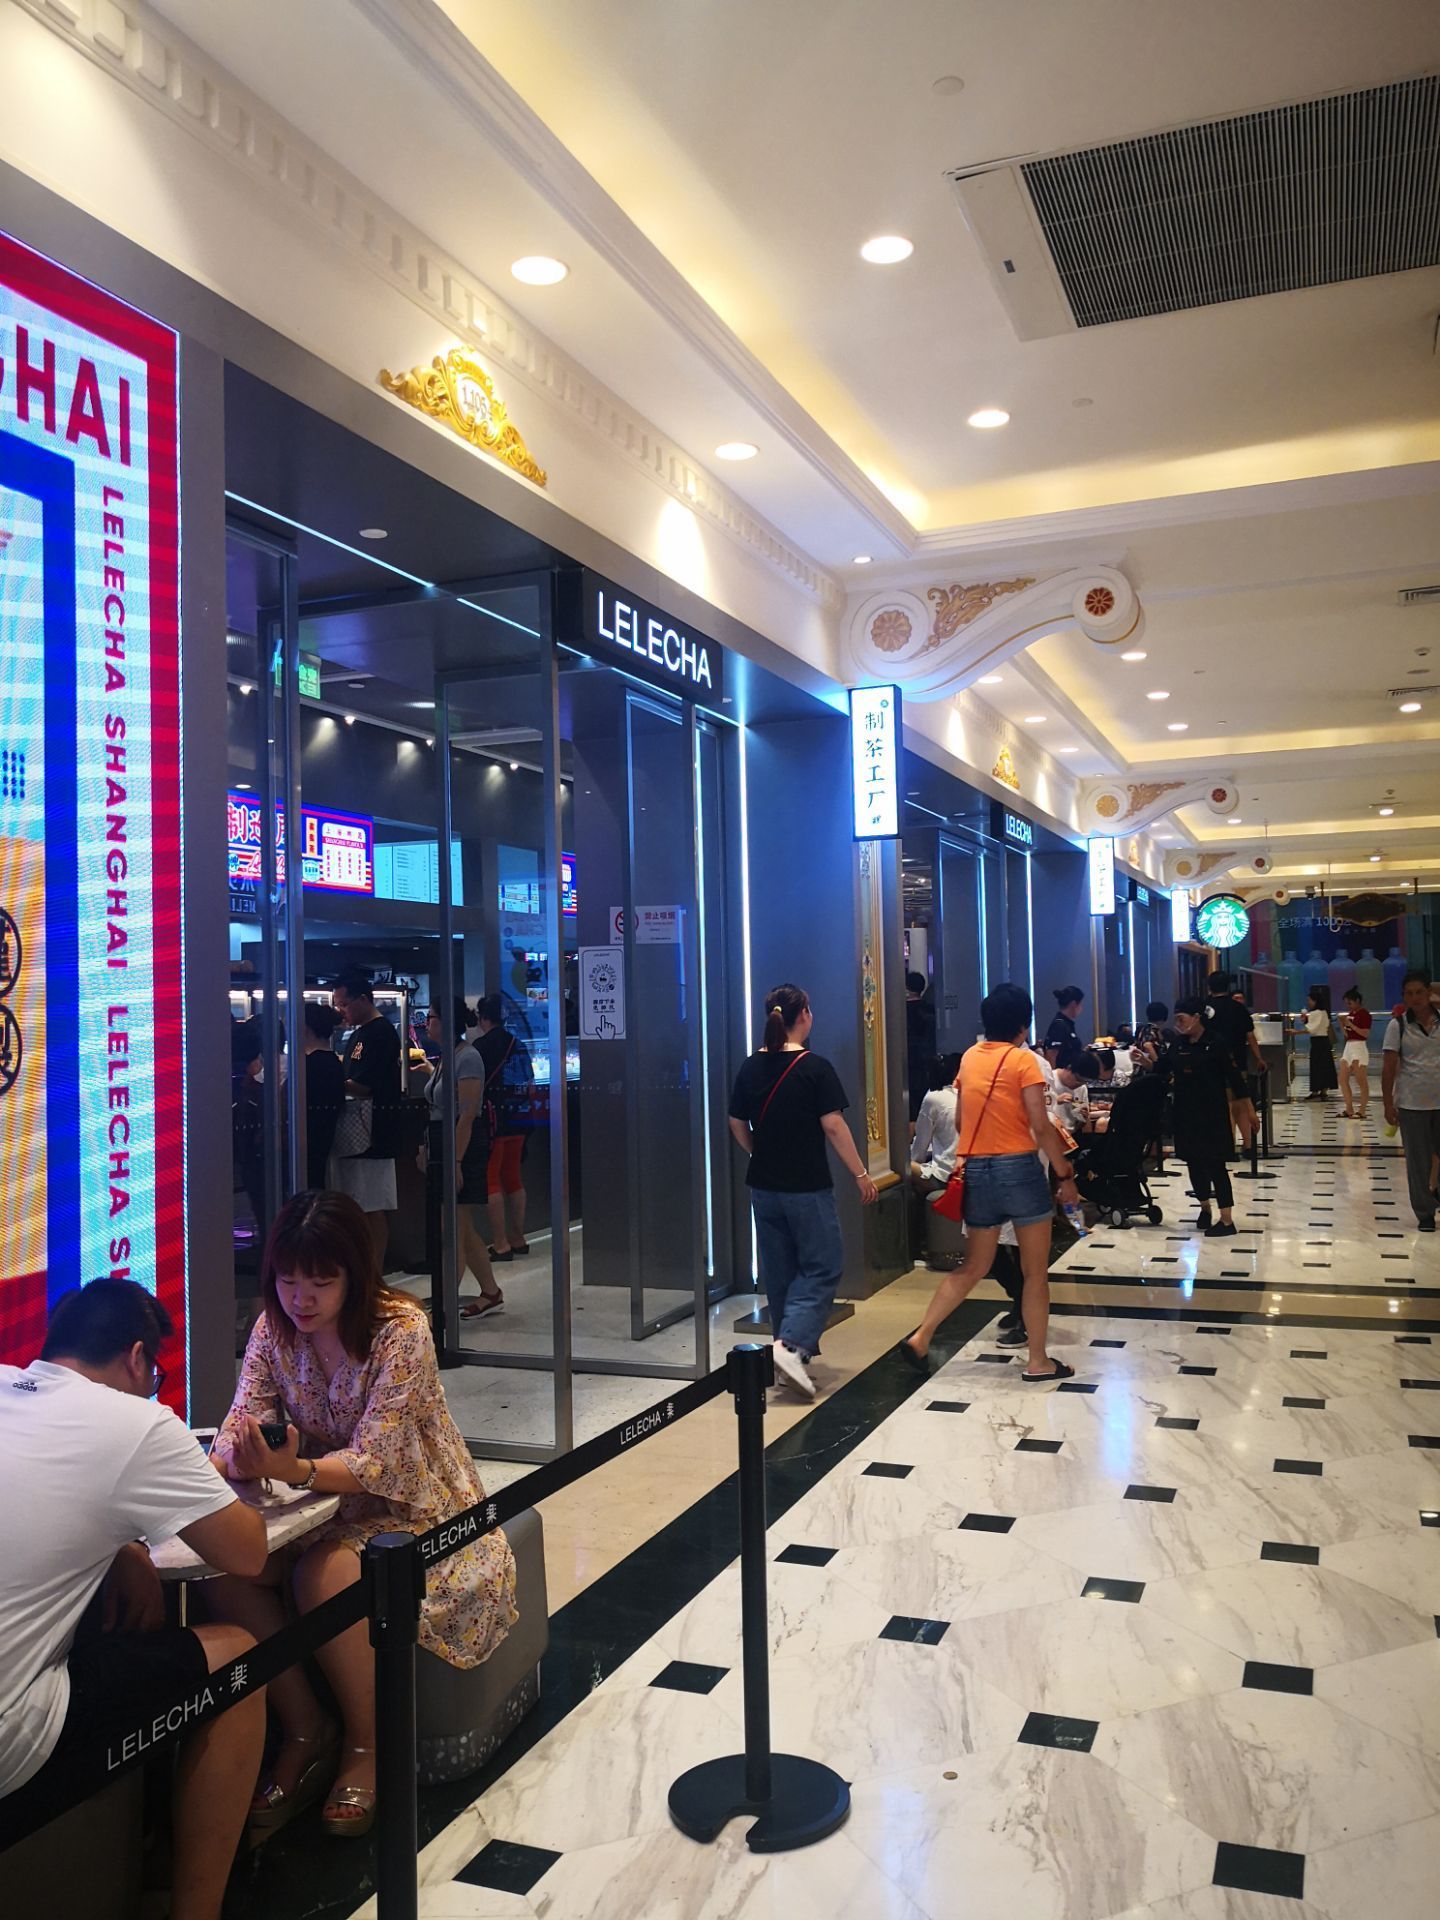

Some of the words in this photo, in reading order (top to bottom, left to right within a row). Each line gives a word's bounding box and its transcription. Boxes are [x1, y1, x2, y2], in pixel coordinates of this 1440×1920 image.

[0, 324, 131, 467] HAI
[102, 485, 127, 693] LELECHA
[598, 591, 712, 689] LELECHA
[865, 710, 886, 809] 制茶工厂
[105, 713, 129, 969] SHANGHAI
[107, 1006, 132, 1221] LELECHA
[12, 1381, 38, 1392] adidas
[620, 1410, 661, 1445] LELECHA
[417, 1516, 477, 1559] ELECHA
[108, 1687, 215, 1771] LELECHA
